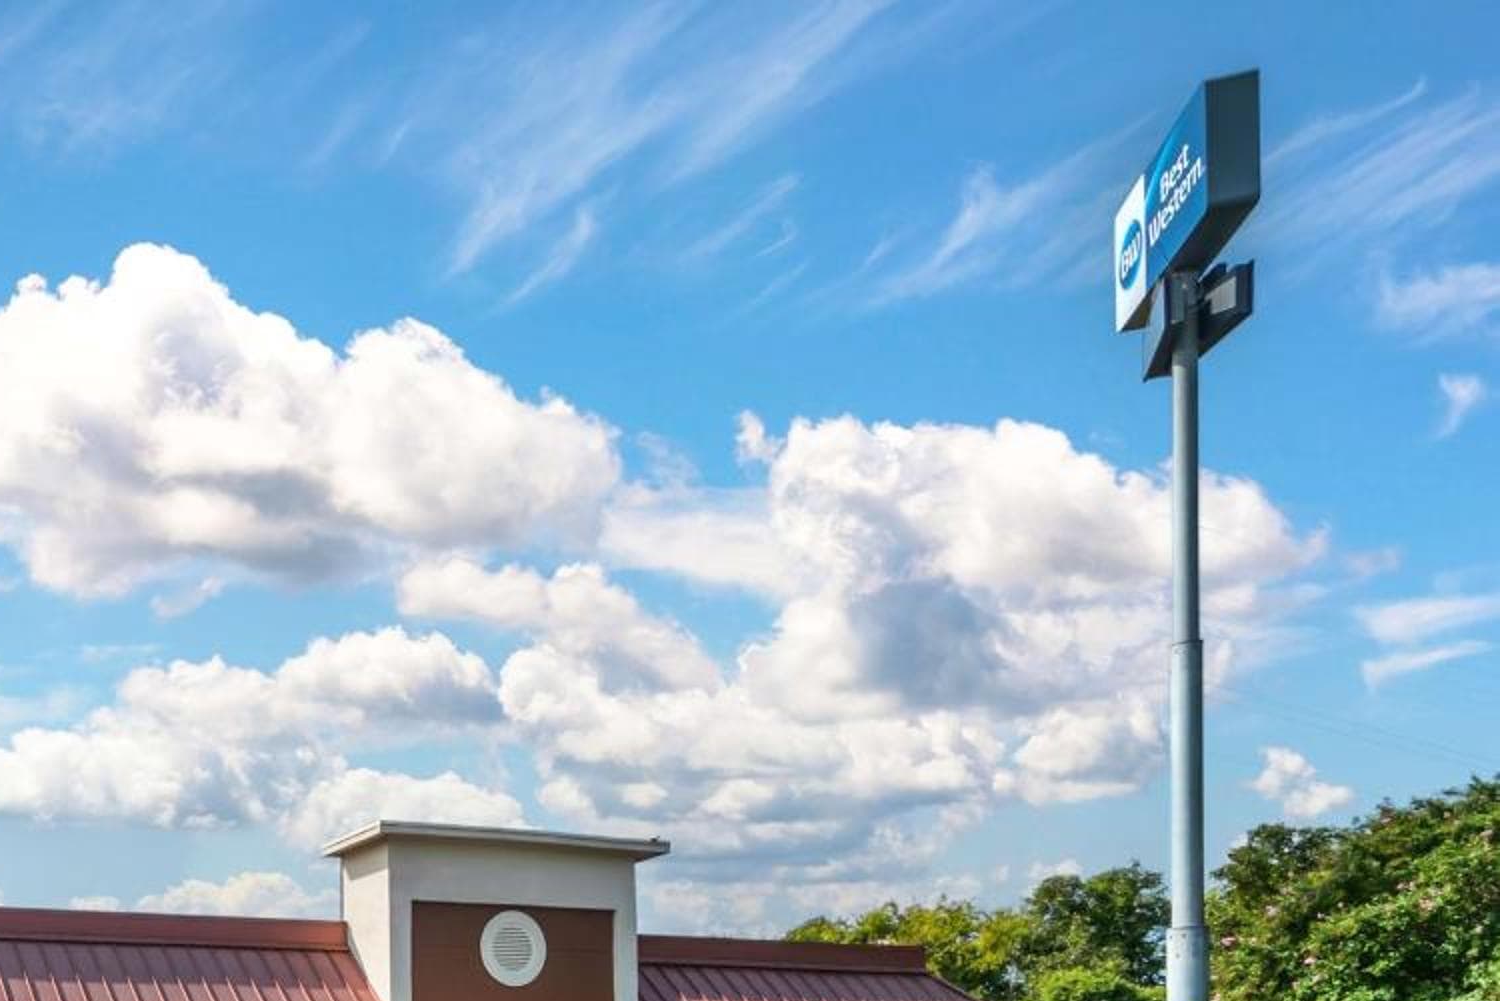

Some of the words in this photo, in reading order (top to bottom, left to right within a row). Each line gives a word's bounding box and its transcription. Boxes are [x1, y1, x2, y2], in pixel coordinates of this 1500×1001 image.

[1148, 156, 1202, 247] Western
[1159, 144, 1189, 203] Best
[1121, 230, 1140, 280] BW
